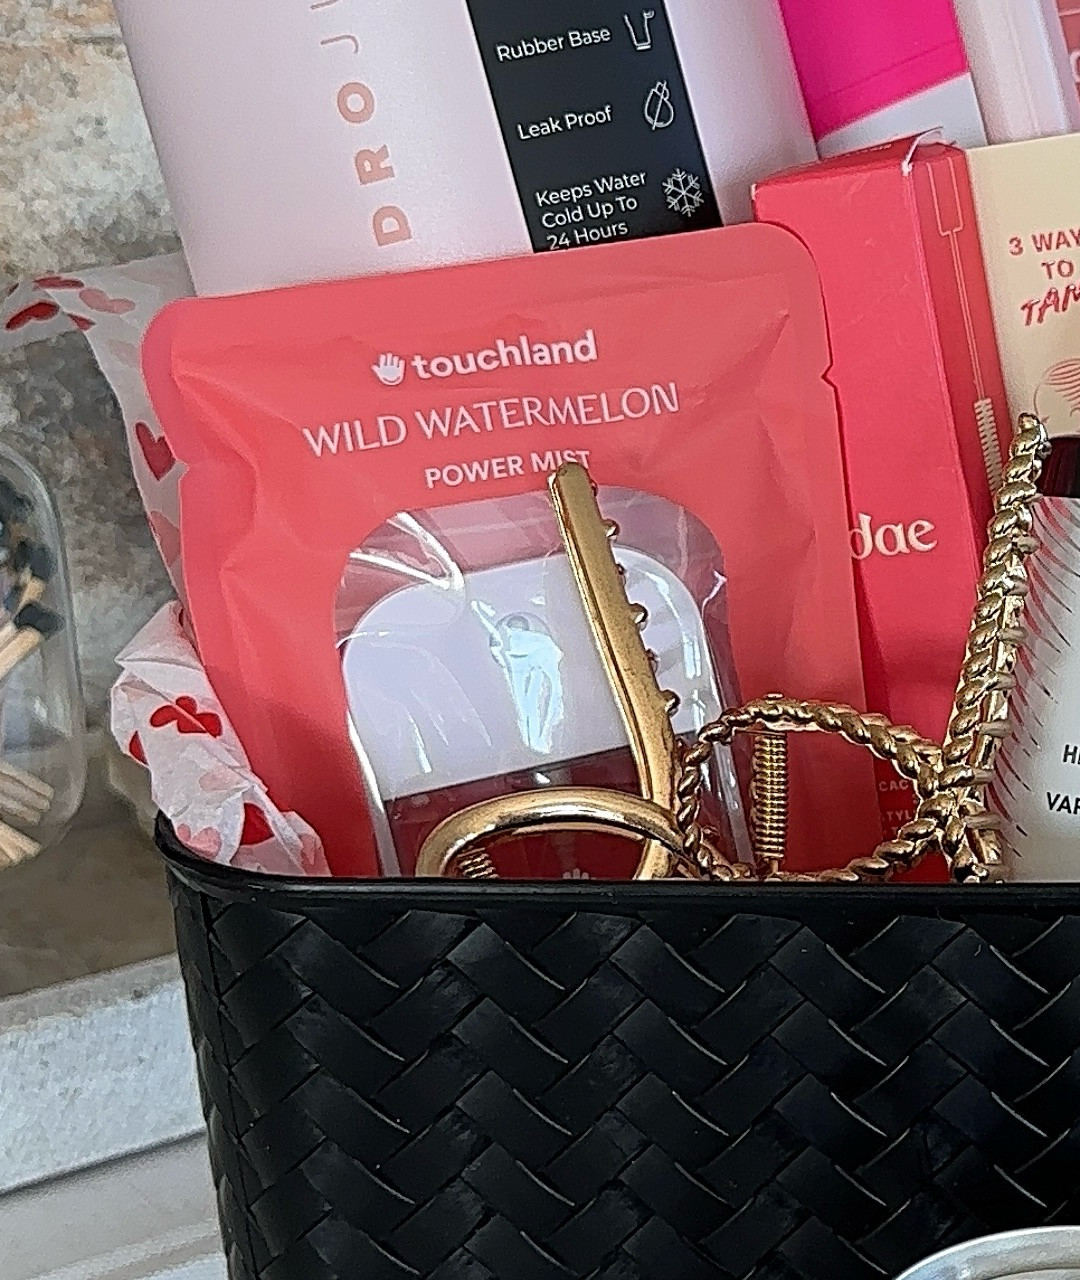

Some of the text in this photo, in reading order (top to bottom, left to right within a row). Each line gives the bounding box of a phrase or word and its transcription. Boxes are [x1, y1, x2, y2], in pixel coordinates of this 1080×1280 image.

[497, 25, 612, 62] Rubber Base
[517, 104, 614, 141] Leak Proof
[535, 169, 647, 210] Keeps Water
[542, 194, 638, 230] Cold Up To
[546, 220, 628, 251] 24 Hours
[1008, 236, 1024, 256] 3
[1040, 258, 1075, 280] TO
[411, 327, 599, 380] touchland
[302, 382, 680, 458] WILD WATERMELON
[424, 449, 590, 490] POWER MIST
[849, 512, 938, 560] dae
